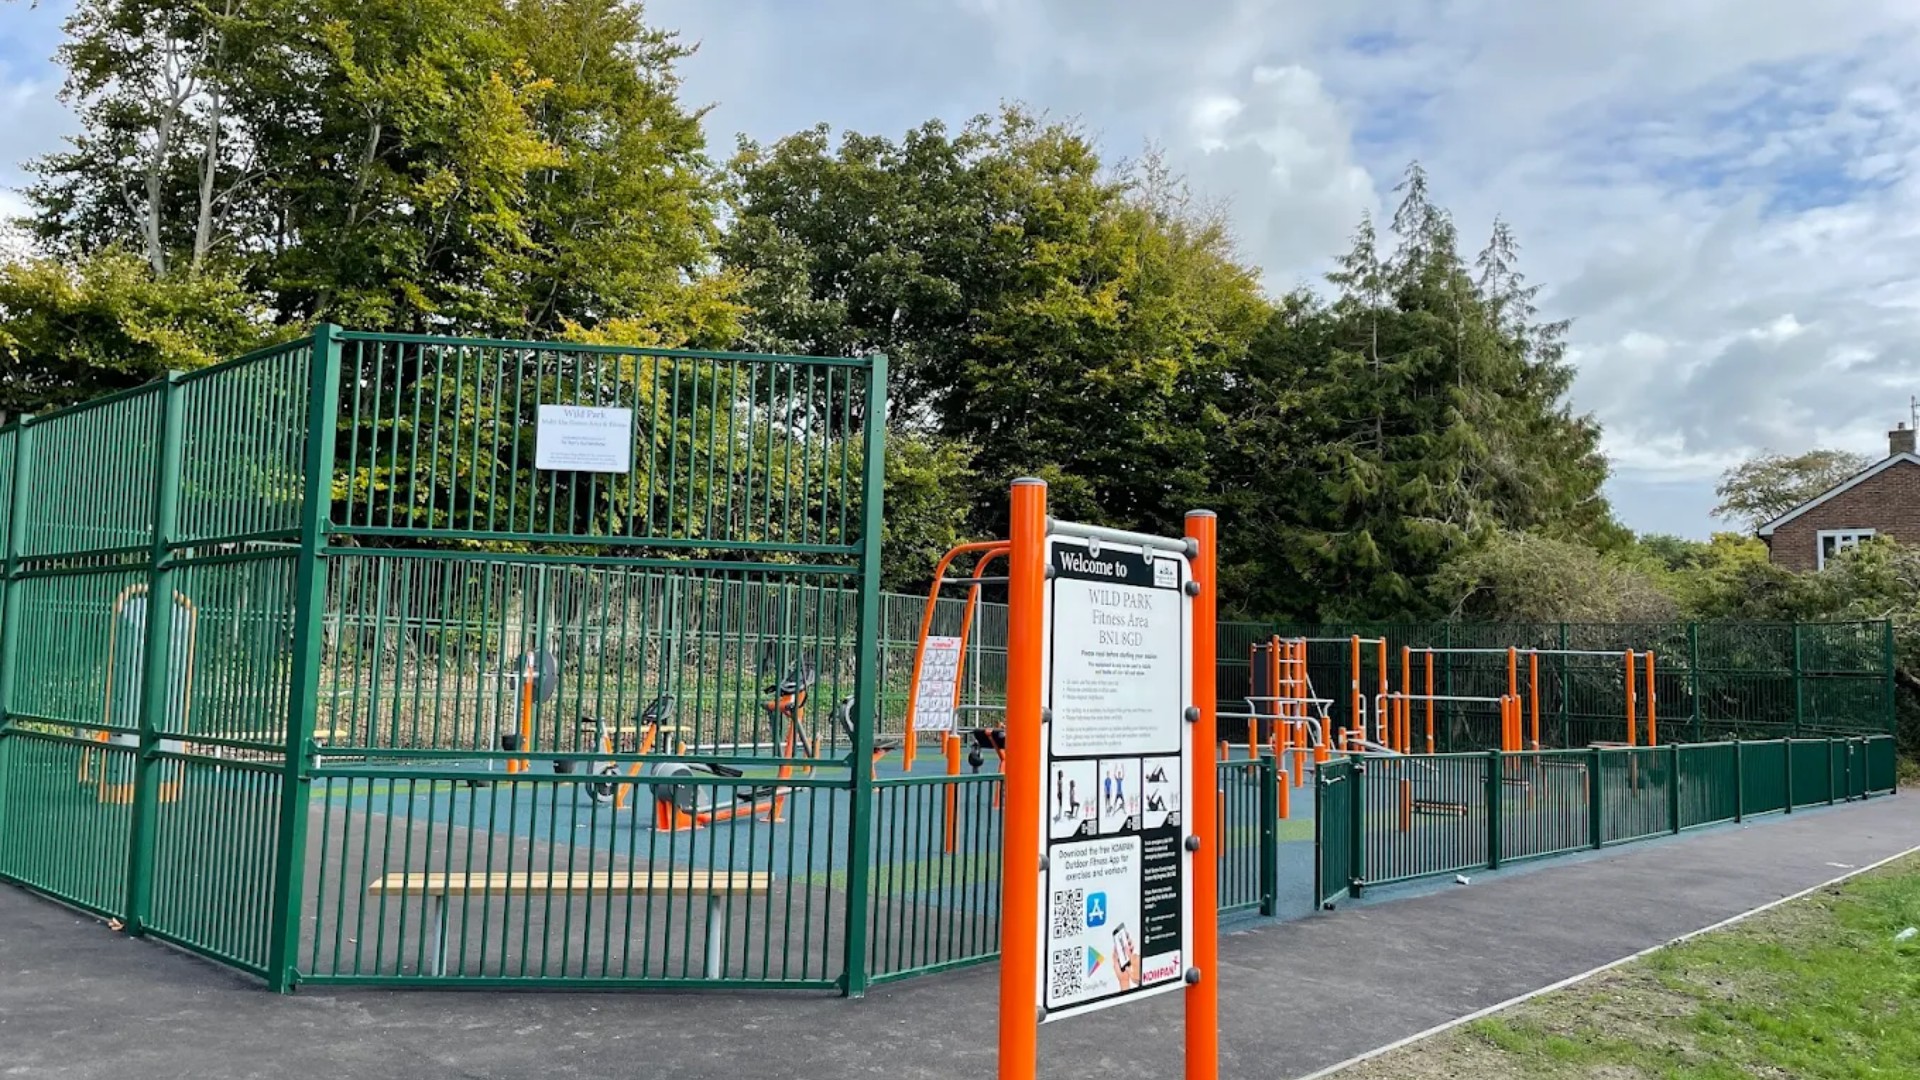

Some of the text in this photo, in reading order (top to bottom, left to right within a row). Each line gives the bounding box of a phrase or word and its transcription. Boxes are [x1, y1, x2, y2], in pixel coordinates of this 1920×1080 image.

[564, 409, 605, 418] Wild Park
[1059, 551, 1128, 577] Welcome to
[1089, 588, 1153, 610] WILD PARK
[1092, 609, 1149, 628] Fitness Area
[1099, 630, 1143, 647] BN1 8GD
[1059, 847, 1087, 859] Download
[1089, 846, 1098, 856] the
[1099, 844, 1110, 855] free
[1111, 842, 1134, 853] KOMPAN
[1065, 854, 1129, 870] Outdoor Fitness App for
[1065, 871, 1091, 881] exercises
[1092, 868, 1103, 878] and
[1143, 966, 1174, 982] KOMPAN
